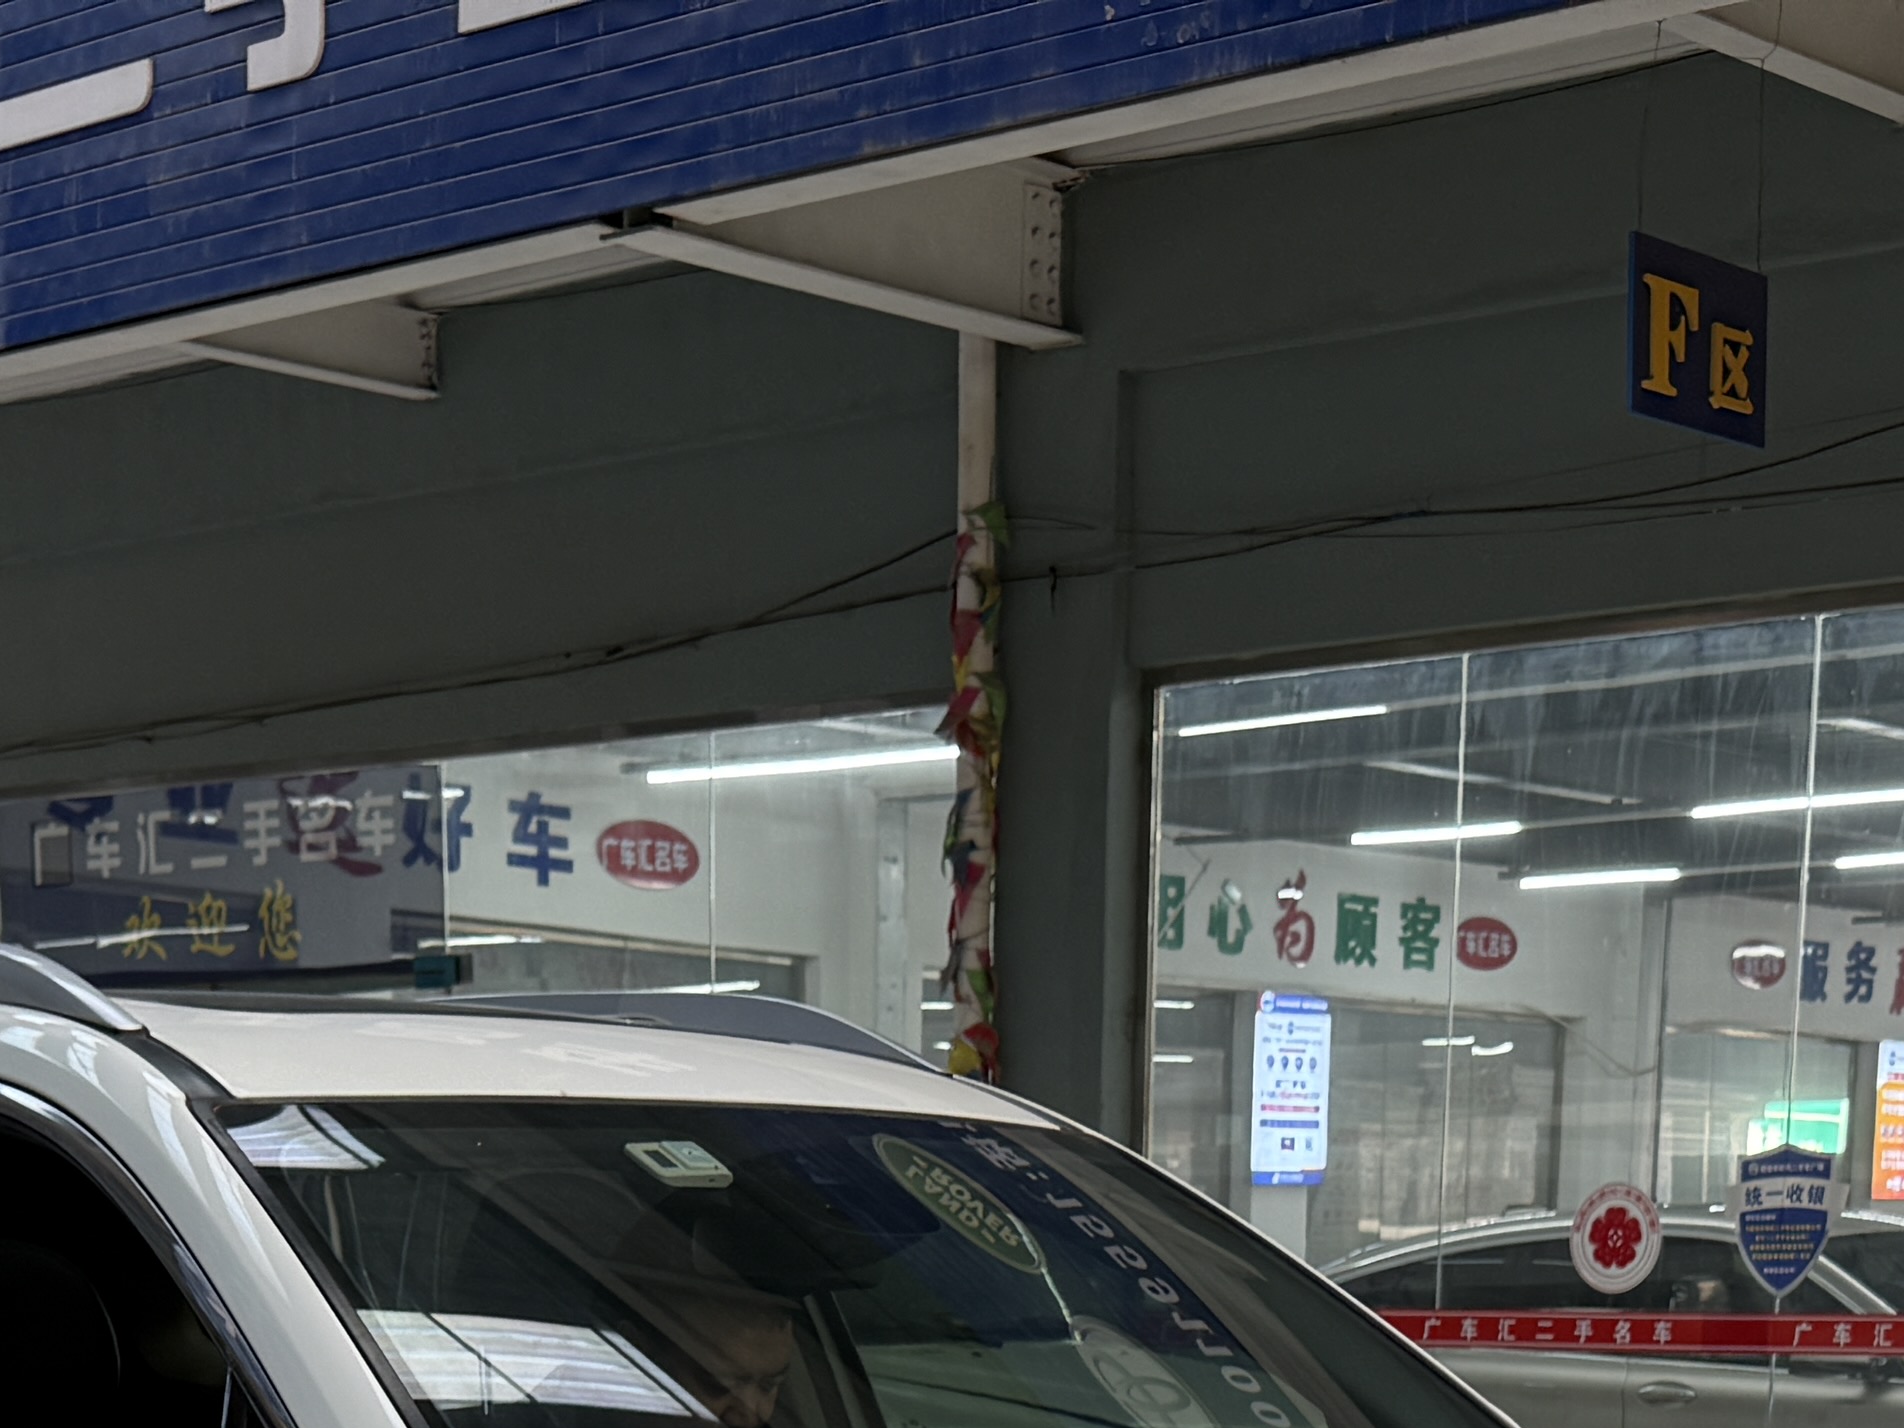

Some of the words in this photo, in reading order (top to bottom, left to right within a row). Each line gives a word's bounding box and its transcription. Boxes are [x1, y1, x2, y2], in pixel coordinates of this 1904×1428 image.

[32, 790, 398, 887] 广车汇二手名车
[602, 837, 689, 874] 广车汇名车
[123, 878, 303, 962] 欢迎您
[1745, 1183, 1826, 1207] 统一收银
[1422, 1316, 1674, 1344] 广车汇二手名车
